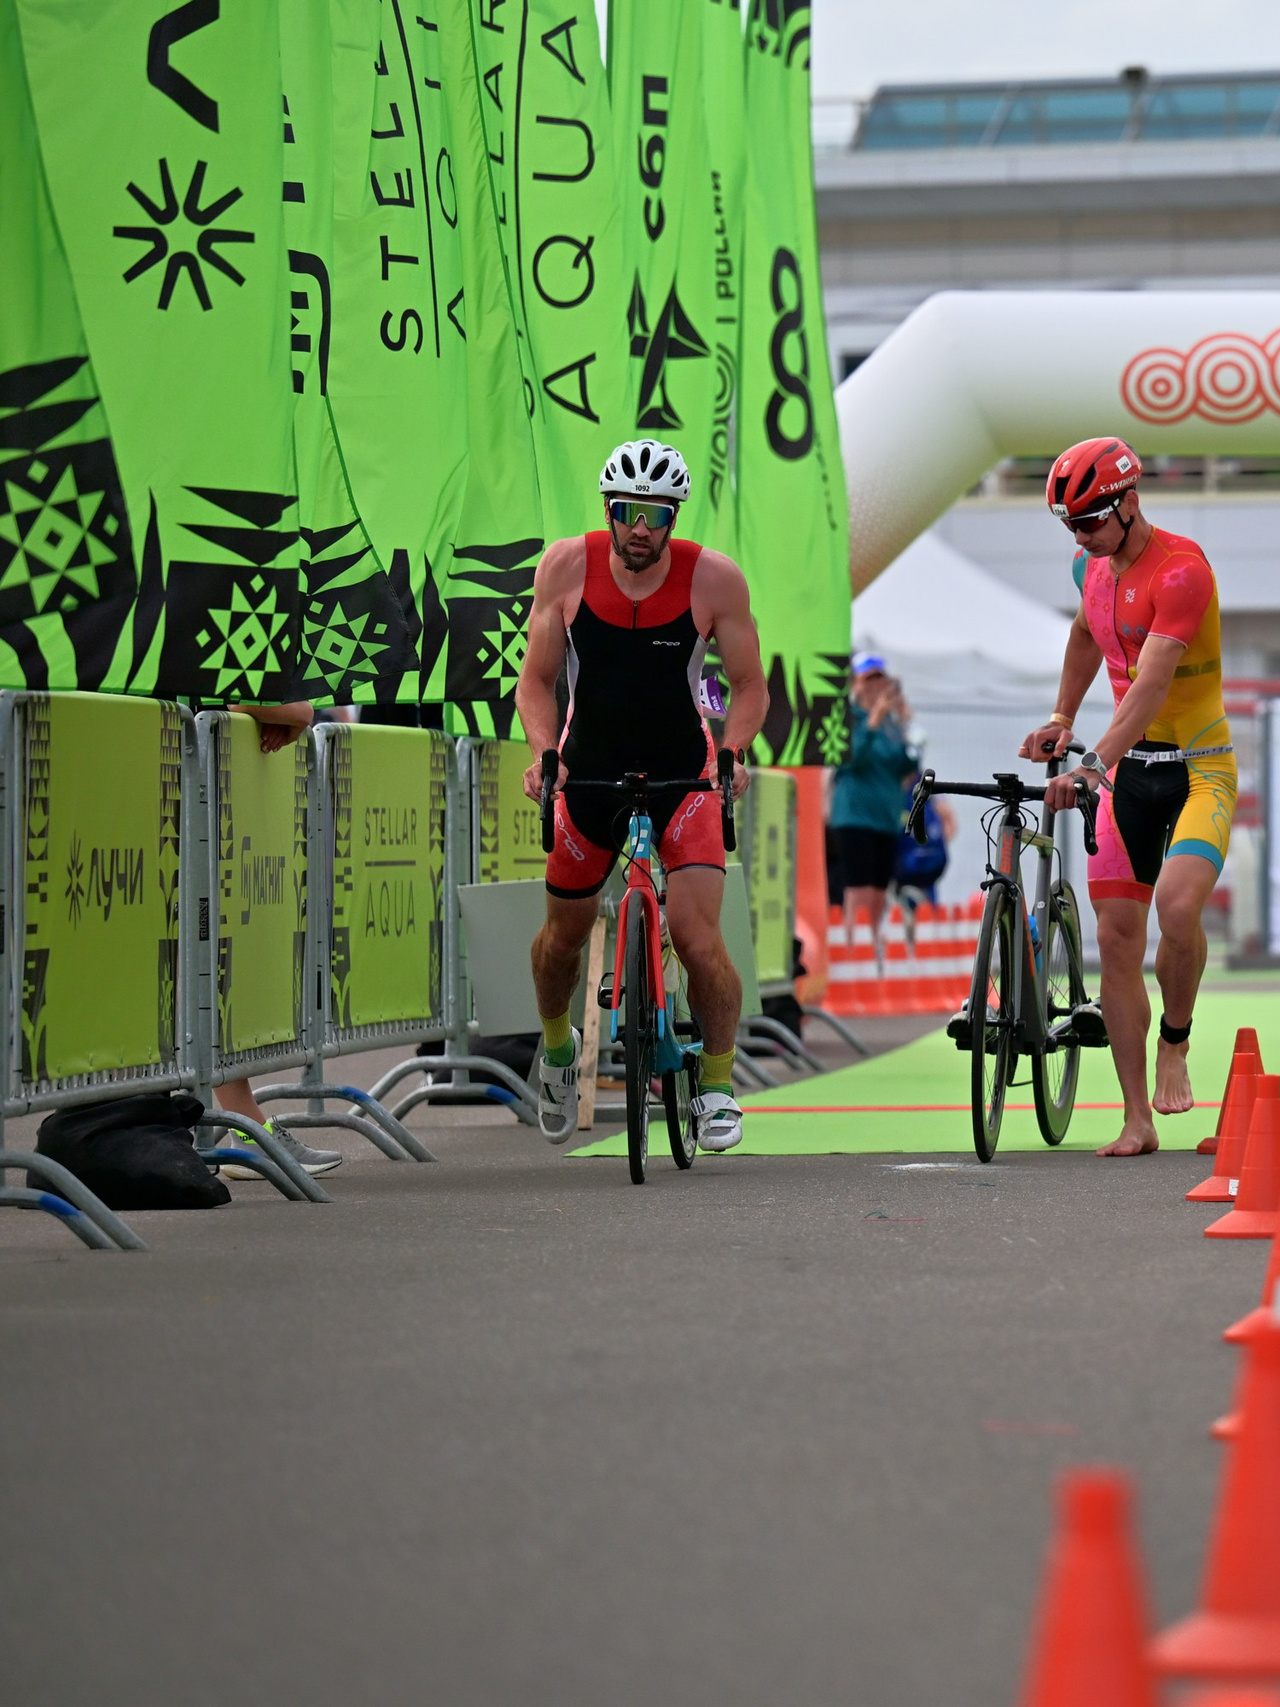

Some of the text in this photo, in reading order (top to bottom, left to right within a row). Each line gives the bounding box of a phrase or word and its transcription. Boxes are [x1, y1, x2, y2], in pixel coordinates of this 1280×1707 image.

[532, 16, 600, 425] AQUA
[635, 484, 650, 492] 1092
[365, 807, 416, 847] STELLAR
[557, 813, 585, 861] orca
[672, 793, 705, 842] orca
[253, 855, 286, 905] МАГНИТ
[365, 880, 416, 937] AQUA
